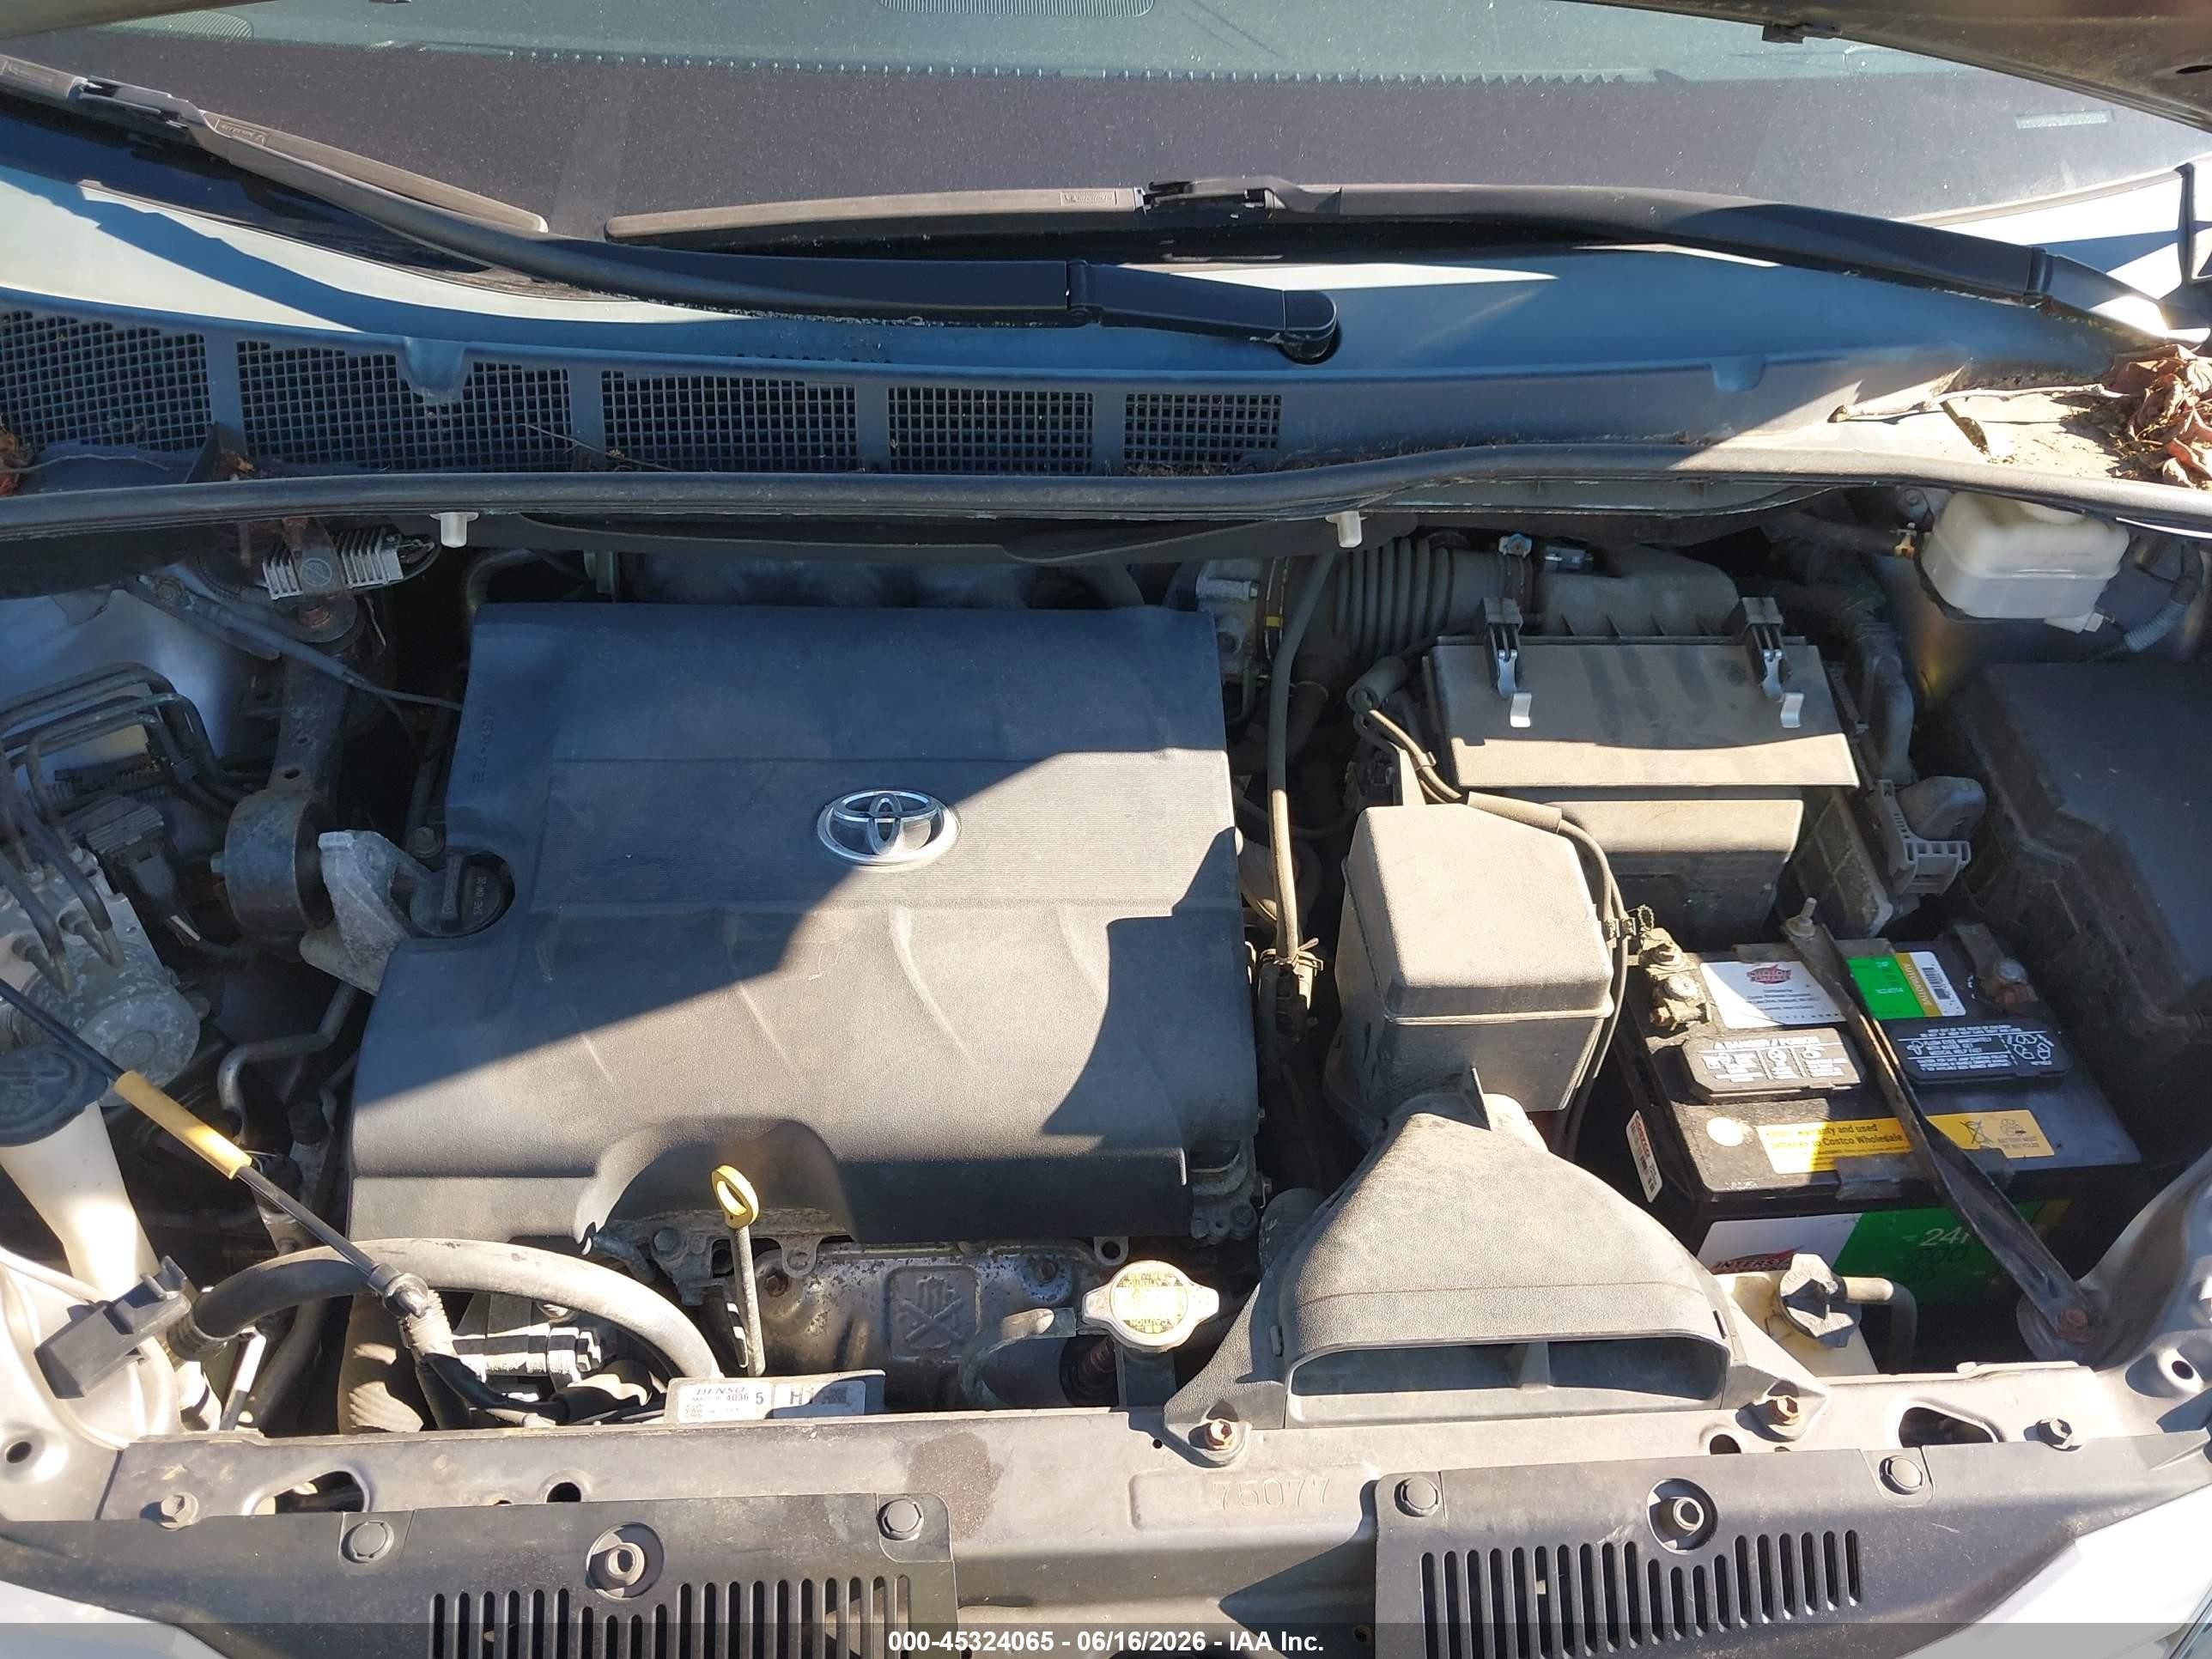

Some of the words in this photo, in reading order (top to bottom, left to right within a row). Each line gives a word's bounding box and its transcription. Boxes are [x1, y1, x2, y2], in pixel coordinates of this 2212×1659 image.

[1902, 963, 1932, 1006] AUTOMOTIVE
[1838, 1125, 1854, 1134] and
[1856, 1123, 1877, 1133] used
[1822, 1138, 1856, 1146] Costco
[1856, 1133, 1903, 1144] Wholesale
[756, 1392, 764, 1405] 5
[1212, 1476, 1330, 1510] 75077
